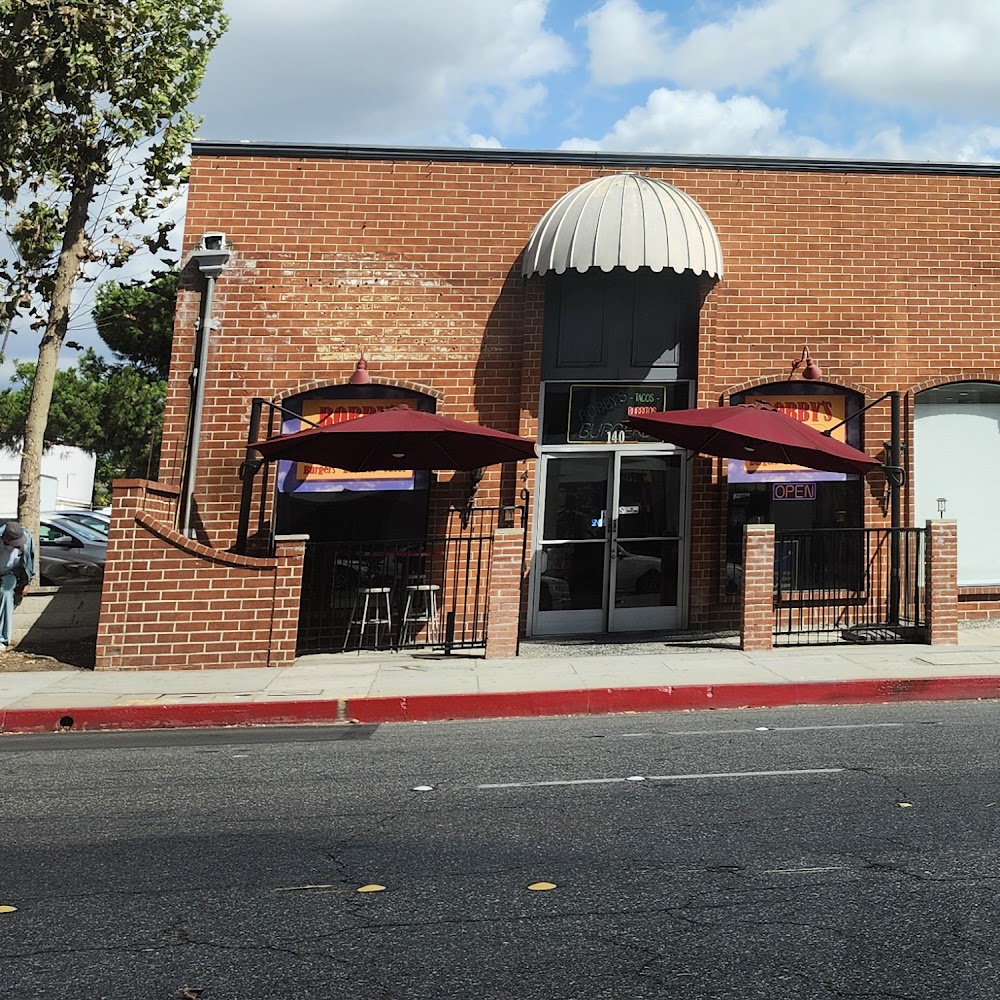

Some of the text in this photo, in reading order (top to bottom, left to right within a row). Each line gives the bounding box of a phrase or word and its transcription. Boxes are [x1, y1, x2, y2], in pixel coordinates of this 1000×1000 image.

[635, 392, 655, 403] TACOS
[767, 400, 832, 422] OBBY'S
[606, 430, 625, 444] 140
[774, 484, 815, 498] OPEN
